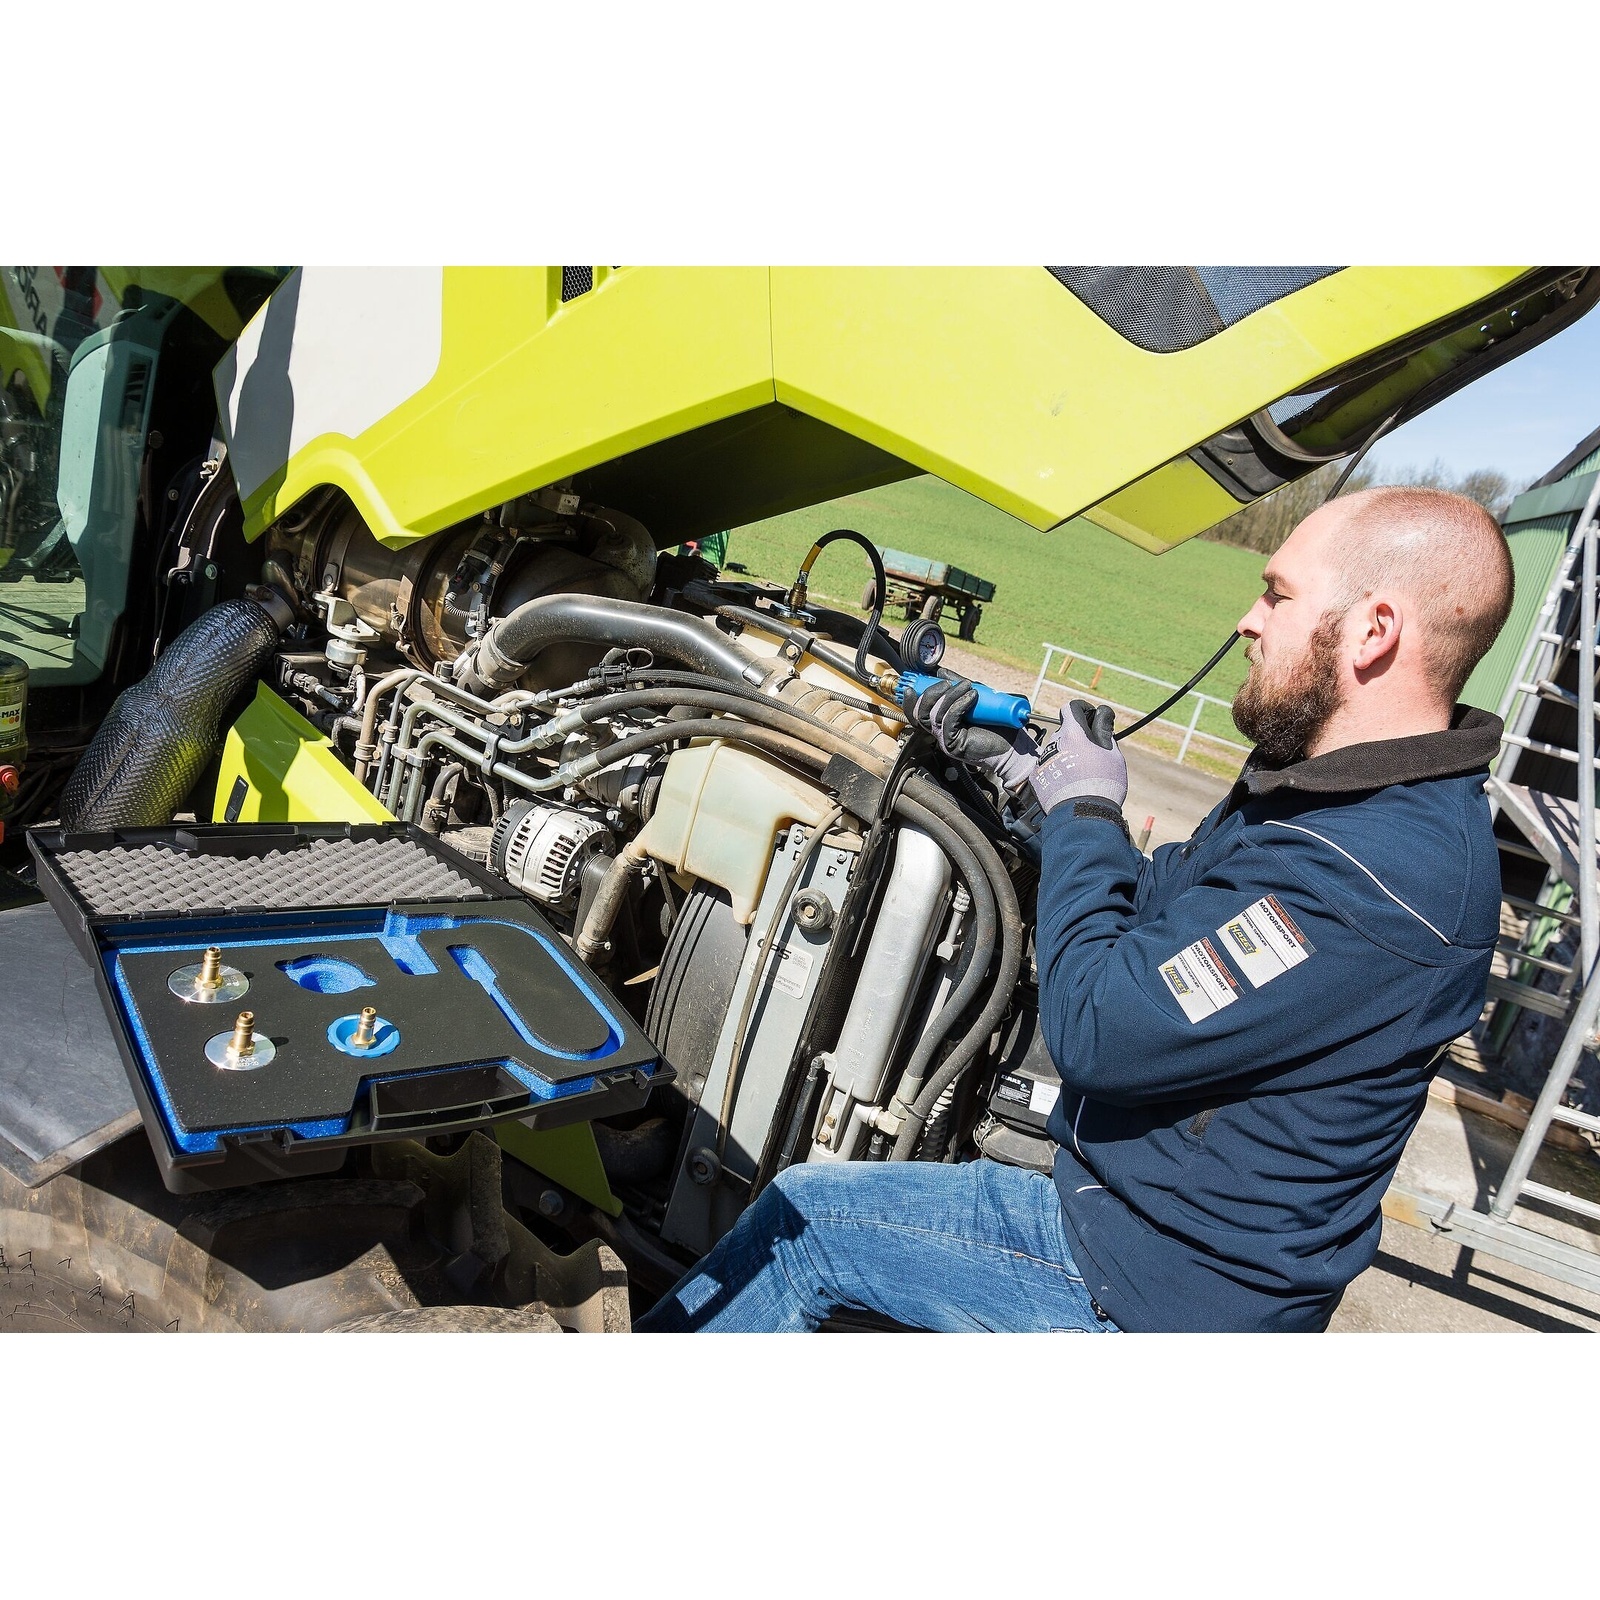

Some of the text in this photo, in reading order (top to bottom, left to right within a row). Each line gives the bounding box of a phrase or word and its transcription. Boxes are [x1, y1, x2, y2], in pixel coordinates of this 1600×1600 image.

[1259, 901, 1297, 949] MOTORSPORT
[1266, 895, 1306, 944] PORSCHE
[1193, 944, 1229, 992] MOTORSPORT
